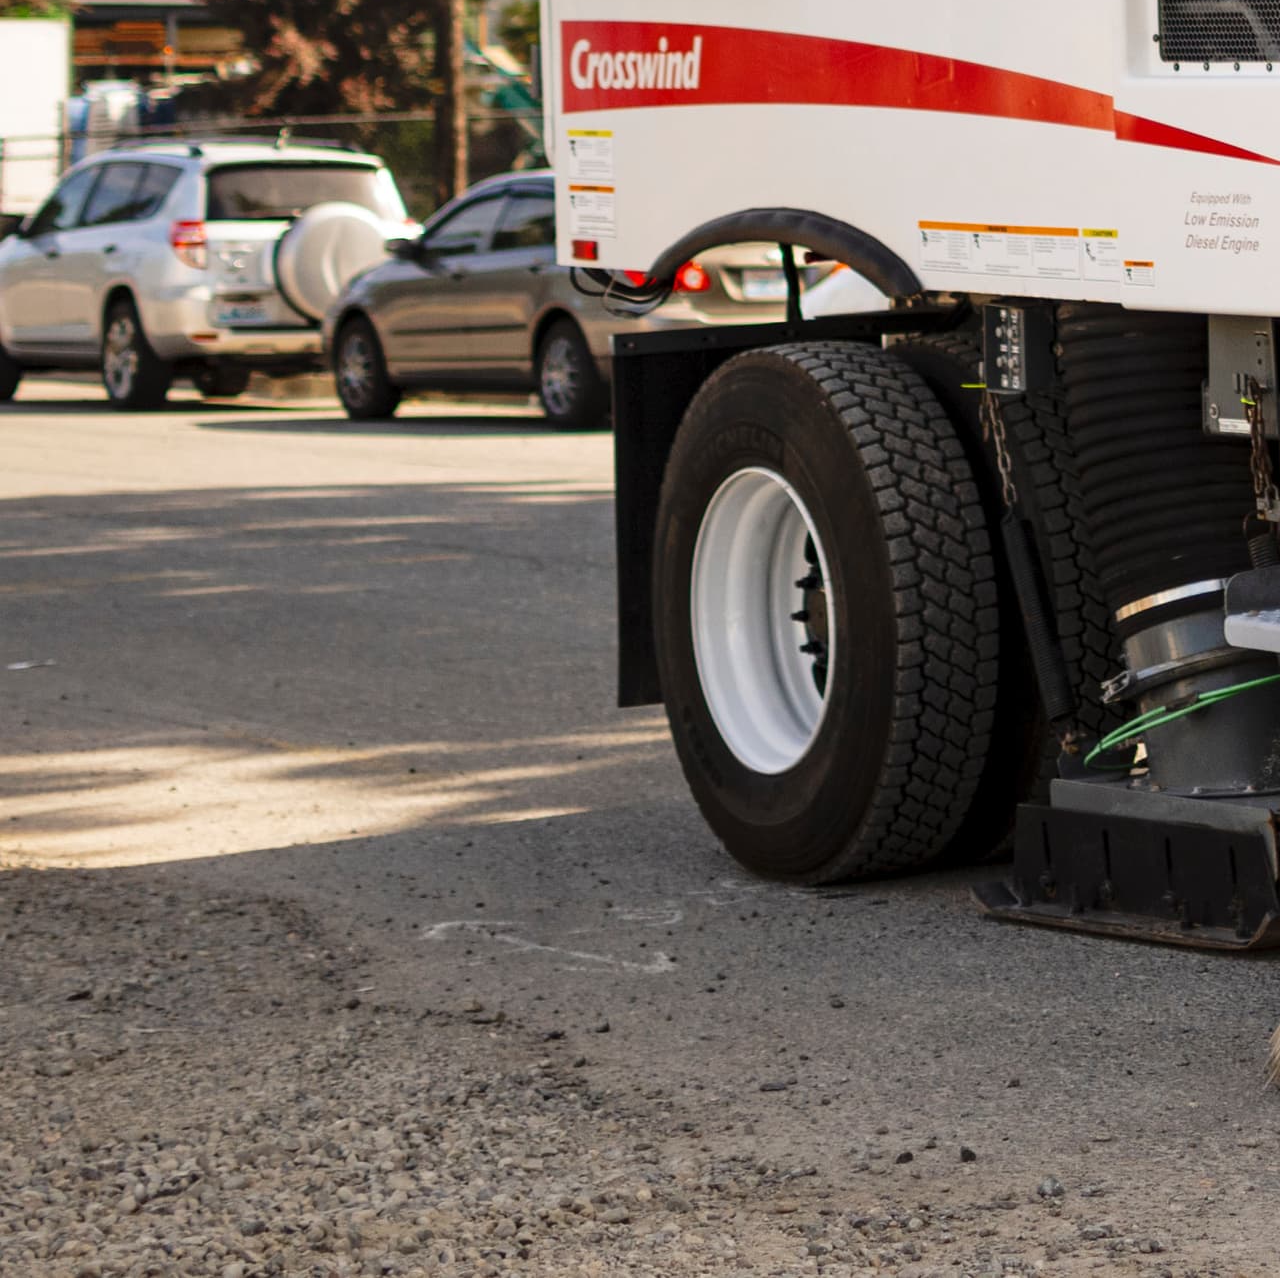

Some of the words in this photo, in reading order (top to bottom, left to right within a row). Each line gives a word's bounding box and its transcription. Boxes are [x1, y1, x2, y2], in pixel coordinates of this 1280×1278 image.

[570, 35, 703, 90] Crosswind
[1184, 210, 1207, 226] Low
[1208, 212, 1260, 228] Emission
[1185, 234, 1220, 250] Diesel
[1220, 235, 1260, 255] Engine
